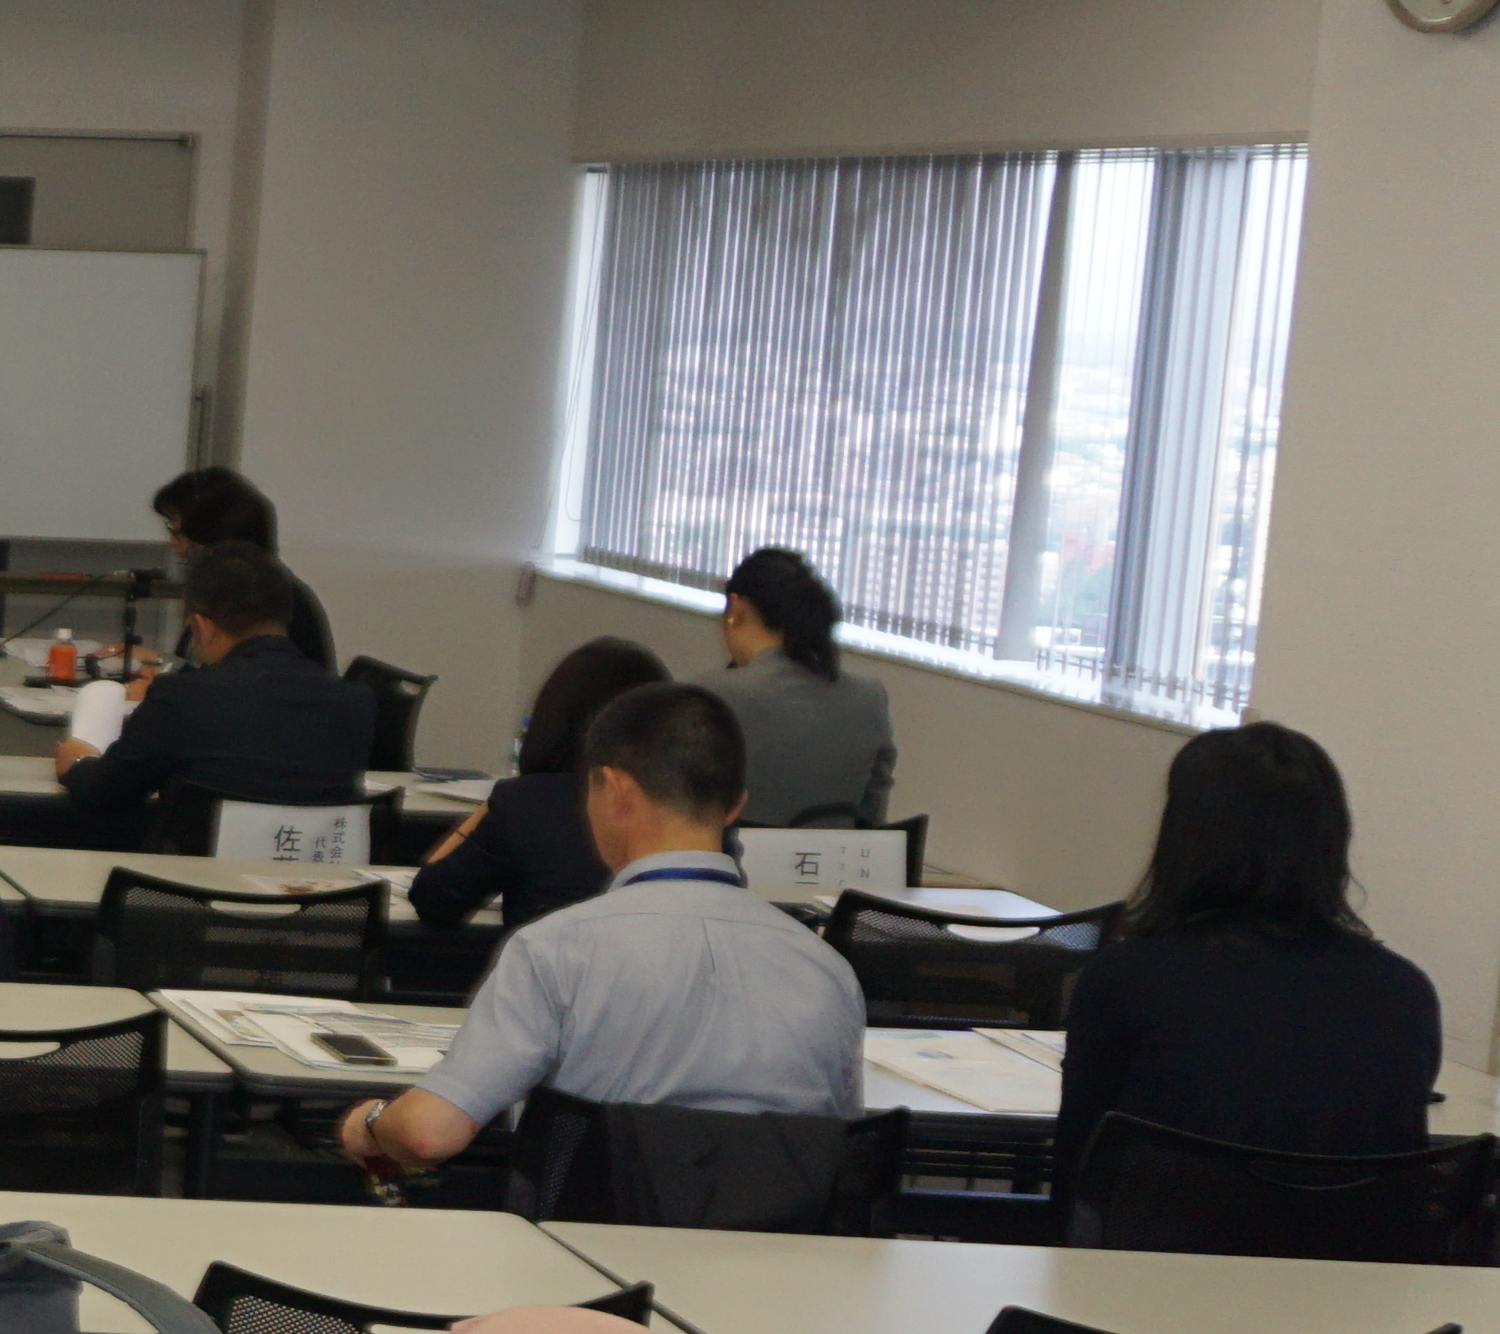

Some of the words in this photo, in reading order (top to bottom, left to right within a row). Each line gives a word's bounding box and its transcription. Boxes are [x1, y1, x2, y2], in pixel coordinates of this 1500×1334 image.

[271, 824, 304, 862] 佐
[329, 817, 348, 864] 株式会
[794, 851, 823, 886] 石
